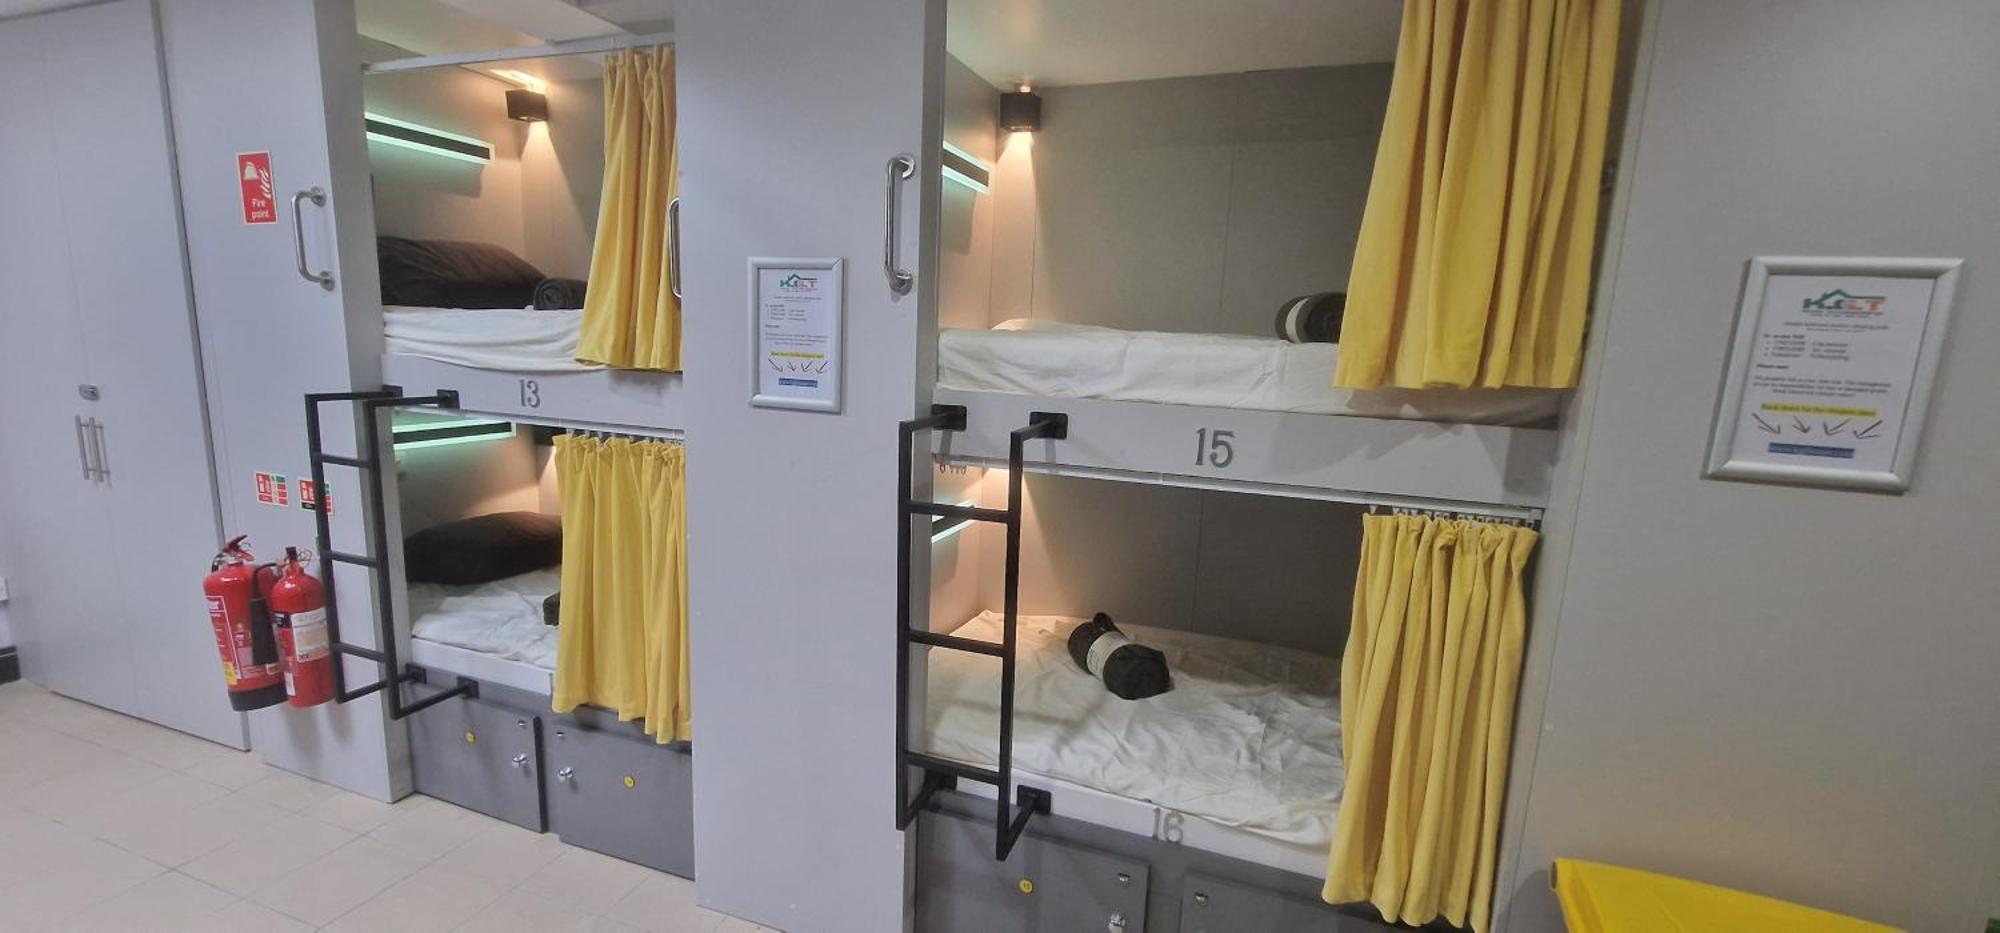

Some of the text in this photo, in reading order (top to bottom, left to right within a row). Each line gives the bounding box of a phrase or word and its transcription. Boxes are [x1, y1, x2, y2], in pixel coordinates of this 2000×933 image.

[252, 199, 266, 208] Fire
[252, 210, 269, 221] point
[519, 379, 541, 409] 13
[1195, 427, 1236, 469] 15
[1151, 807, 1185, 843] 16
